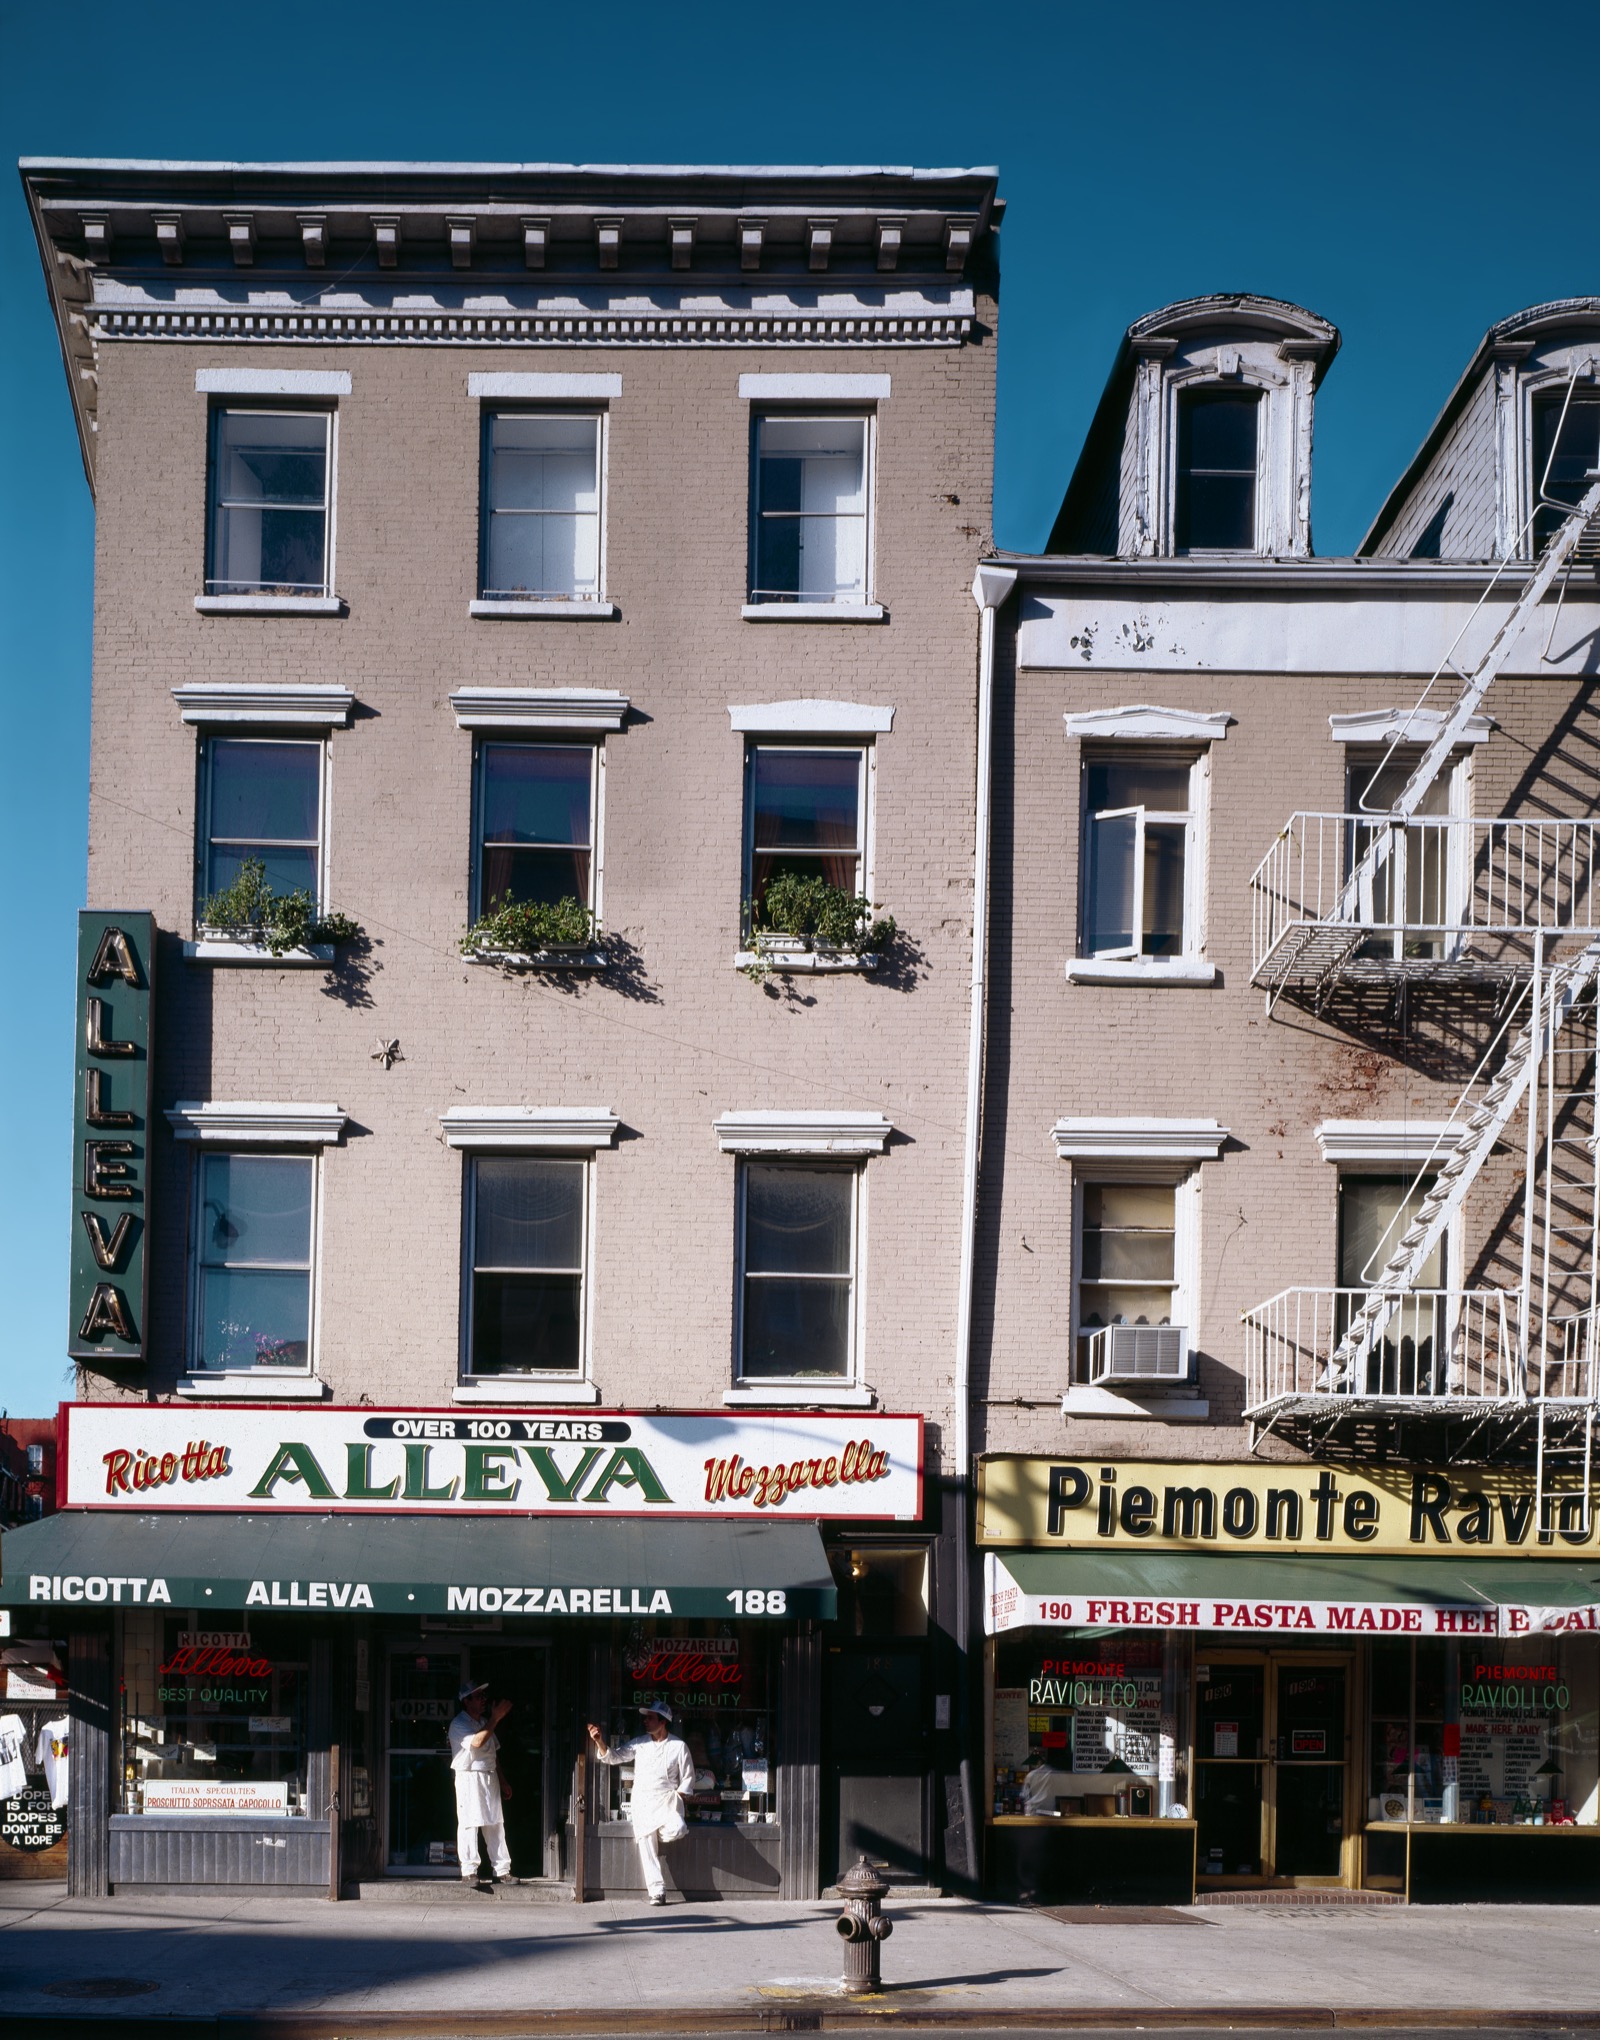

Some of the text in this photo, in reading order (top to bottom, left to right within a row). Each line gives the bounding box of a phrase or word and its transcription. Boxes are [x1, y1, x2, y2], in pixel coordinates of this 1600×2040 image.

[79, 926, 140, 1339] ALLEVA
[392, 1420, 603, 1441] OVER 100 YEARS
[103, 1439, 890, 1507] Ricotta ALLEVA Mozzarella
[1046, 1466, 1600, 1544] Piemonte Ravio
[29, 1576, 786, 1615] RICOTTA ALLEVA MOZZARELLA 188
[1005, 1587, 1018, 1601] PASTA
[1004, 1600, 1016, 1613] HERE
[1039, 1602, 1072, 1620] 190
[1086, 1600, 1201, 1626] FRESH
[1213, 1605, 1317, 1629] PASTA
[1327, 1607, 1422, 1632] MADE
[1543, 1608, 1600, 1631] DAI
[181, 1633, 249, 1647] RICOTTA
[653, 1639, 738, 1654] MOZZARELLA
[160, 1646, 273, 1677] Alleva
[632, 1652, 743, 1683] Alleva
[866, 1656, 893, 1671] 188
[1043, 1660, 1125, 1677] PIEMONTE
[1475, 1665, 1557, 1681] PIEMONTE
[1030, 1679, 1137, 1708] RAVIOLI CO
[1205, 1684, 1231, 1702] 190
[1289, 1678, 1316, 1695] 190
[158, 1688, 268, 1702] BEST QUALITY
[633, 1691, 741, 1707] BEST QUALITY
[1462, 1684, 1569, 1709] RAVIOLI CO
[401, 1702, 449, 1716] OPEN
[1137, 1700, 1161, 1708] DAILY
[1466, 1724, 1540, 1735] MADE HERE DAILY
[1294, 1739, 1324, 1751] OPEN
[13, 1790, 50, 1800] DOPE
[171, 1787, 256, 1795] ITALIAN SPECIALTIES
[6, 1801, 20, 1811] IS
[147, 1798, 190, 1808] PROSCIUTTO
[239, 1799, 281, 1808] CAPOCOLLO
[7, 1812, 57, 1823] DOPES
[2, 1824, 62, 1834] DON'T BE
[12, 1835, 52, 1845] A DOPE
